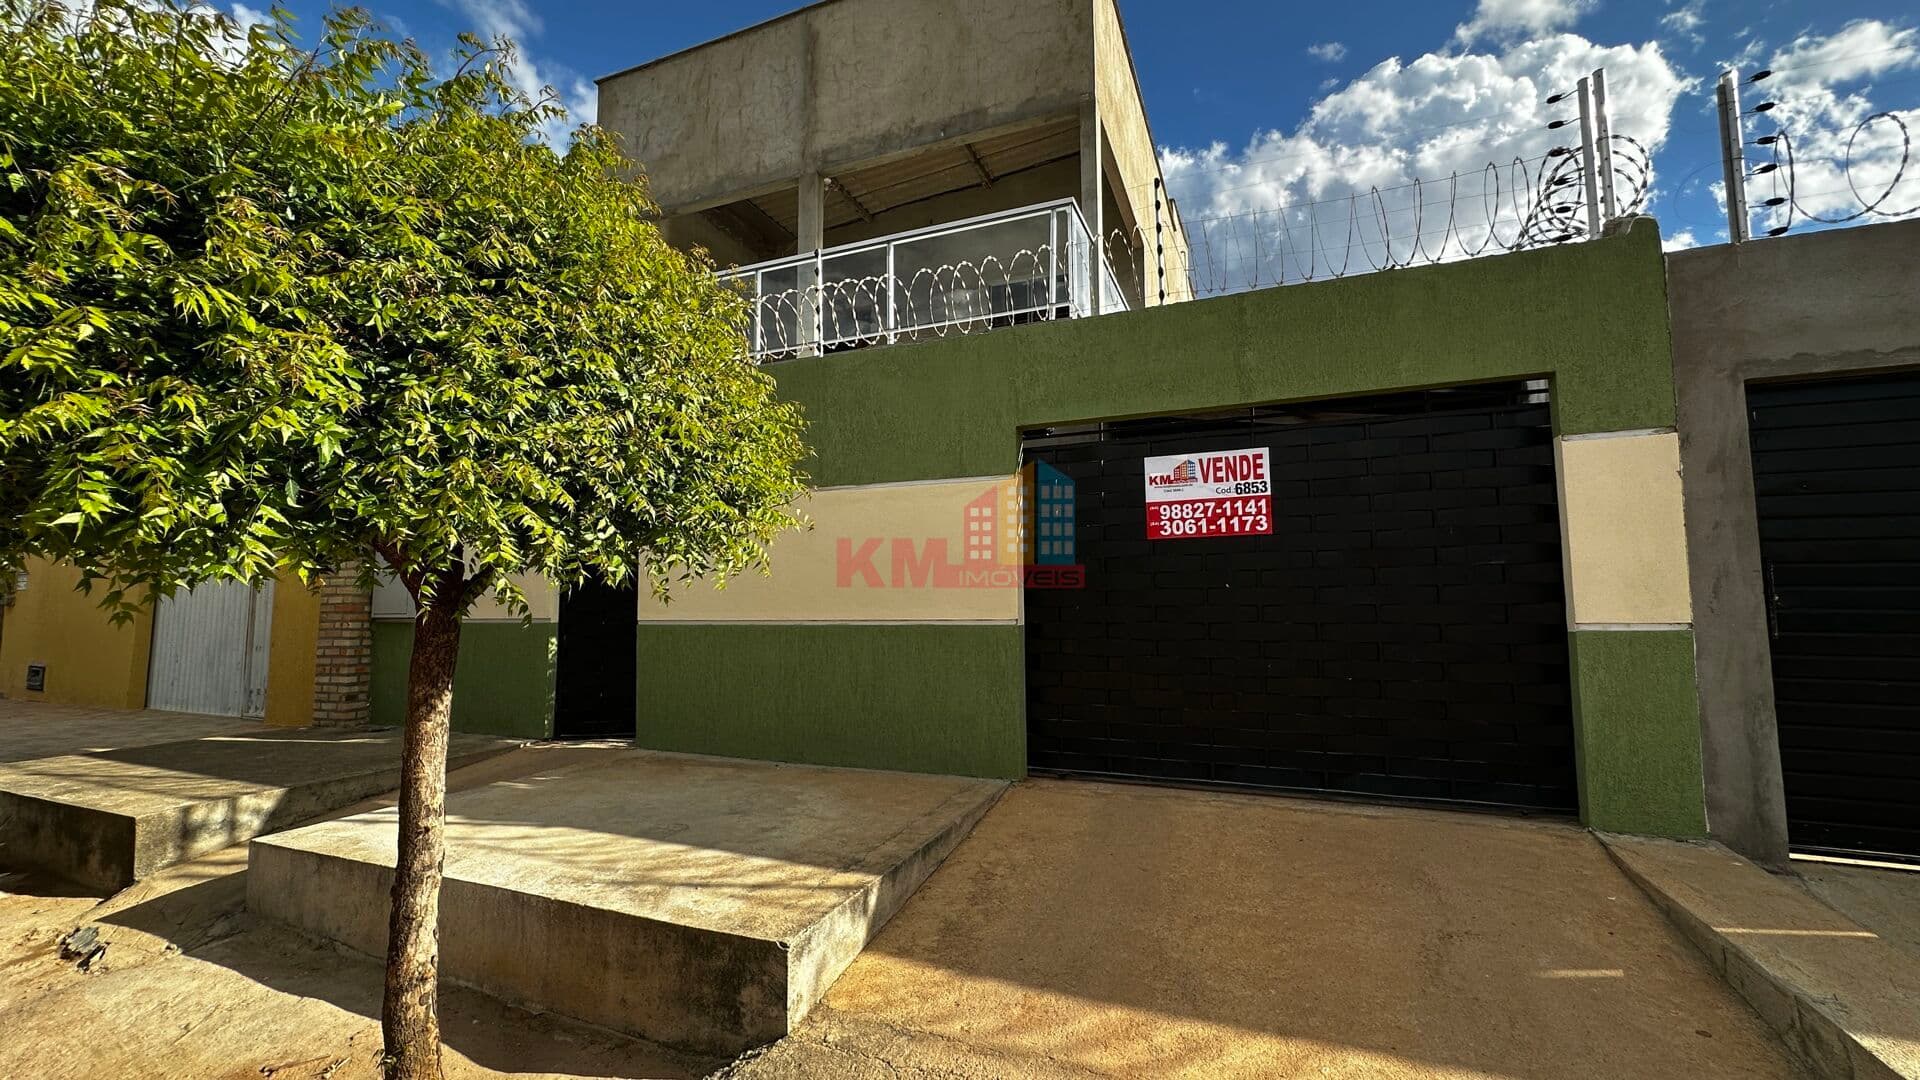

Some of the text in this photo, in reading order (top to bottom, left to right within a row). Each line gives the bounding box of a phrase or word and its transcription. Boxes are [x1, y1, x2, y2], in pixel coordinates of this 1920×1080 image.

[1198, 453, 1264, 483] VENDE
[1149, 475, 1175, 486] KM
[1235, 480, 1268, 496] 6853
[1159, 498, 1267, 519] 98827-1141
[1159, 515, 1268, 536] 3061-1173
